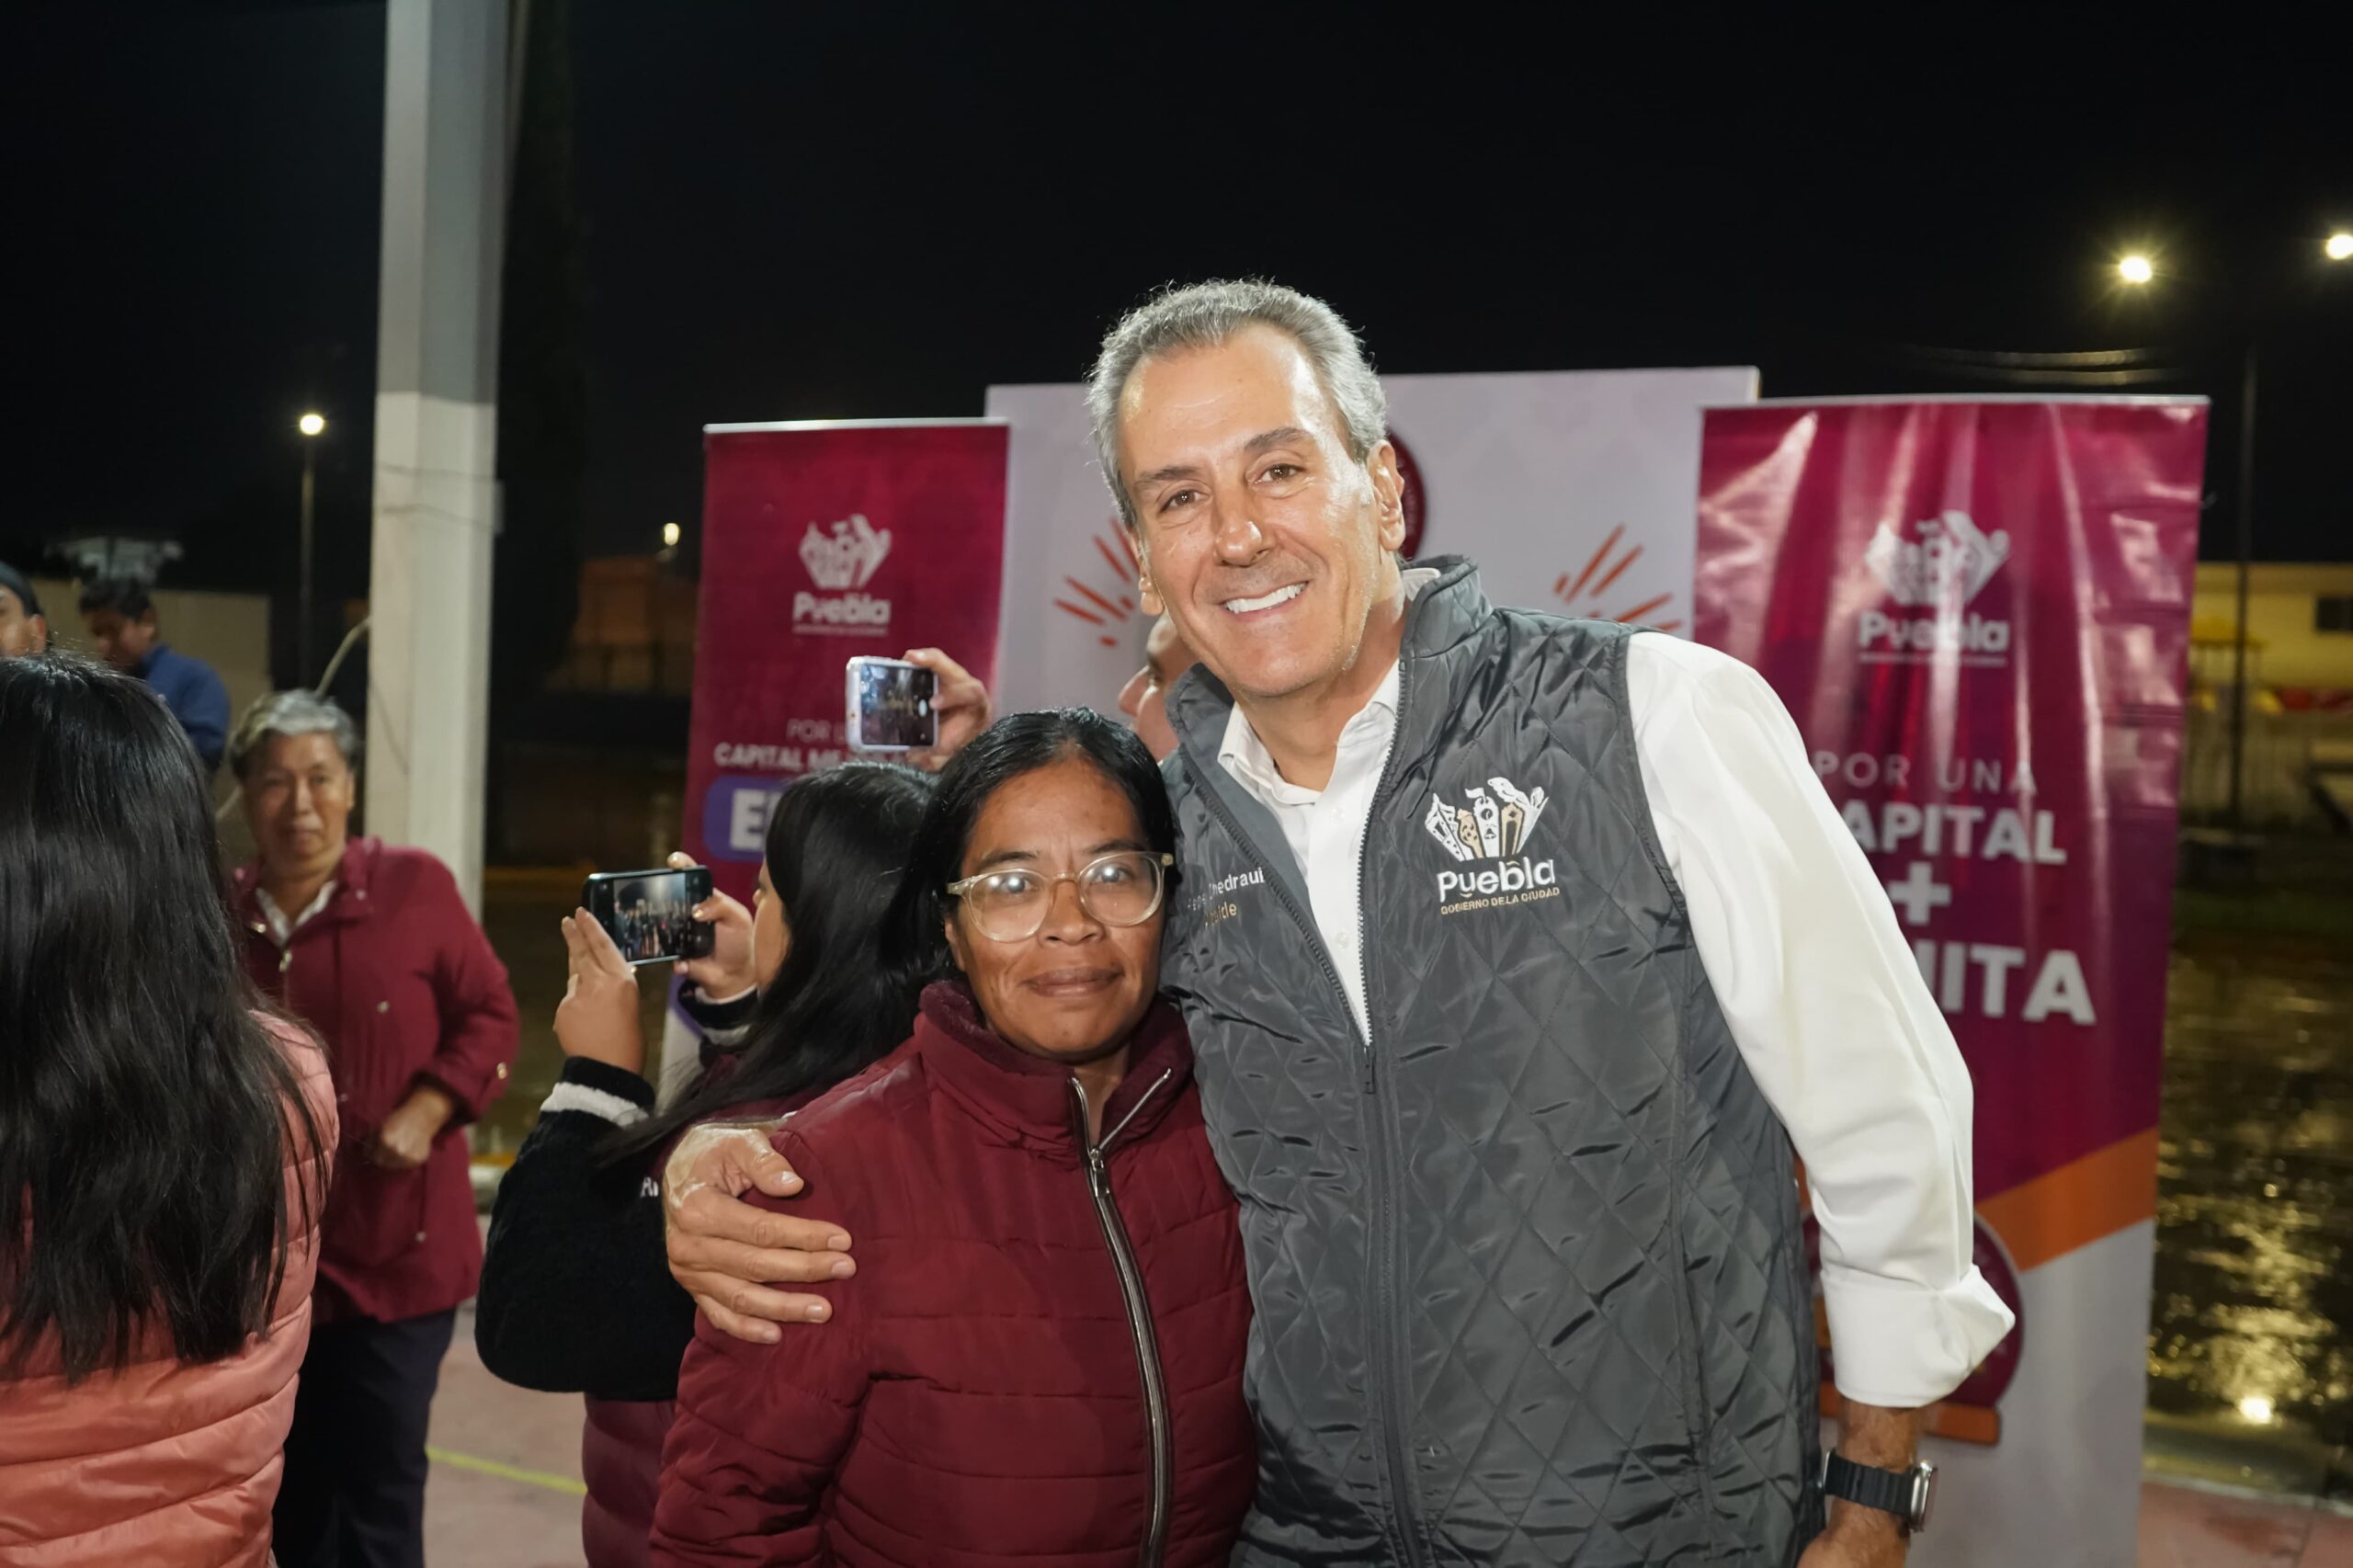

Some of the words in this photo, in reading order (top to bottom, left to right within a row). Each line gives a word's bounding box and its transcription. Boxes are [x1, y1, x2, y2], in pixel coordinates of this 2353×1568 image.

[792, 591, 891, 625] Puebla
[786, 719, 831, 743] POR
[713, 742, 801, 771] CAPITAL
[1813, 750, 1911, 788] POR
[1935, 757, 2037, 794] UNA
[1838, 798, 2067, 864] APITAL
[1440, 898, 1490, 915] GOBIERNO
[1520, 886, 1561, 903] CIUDAD
